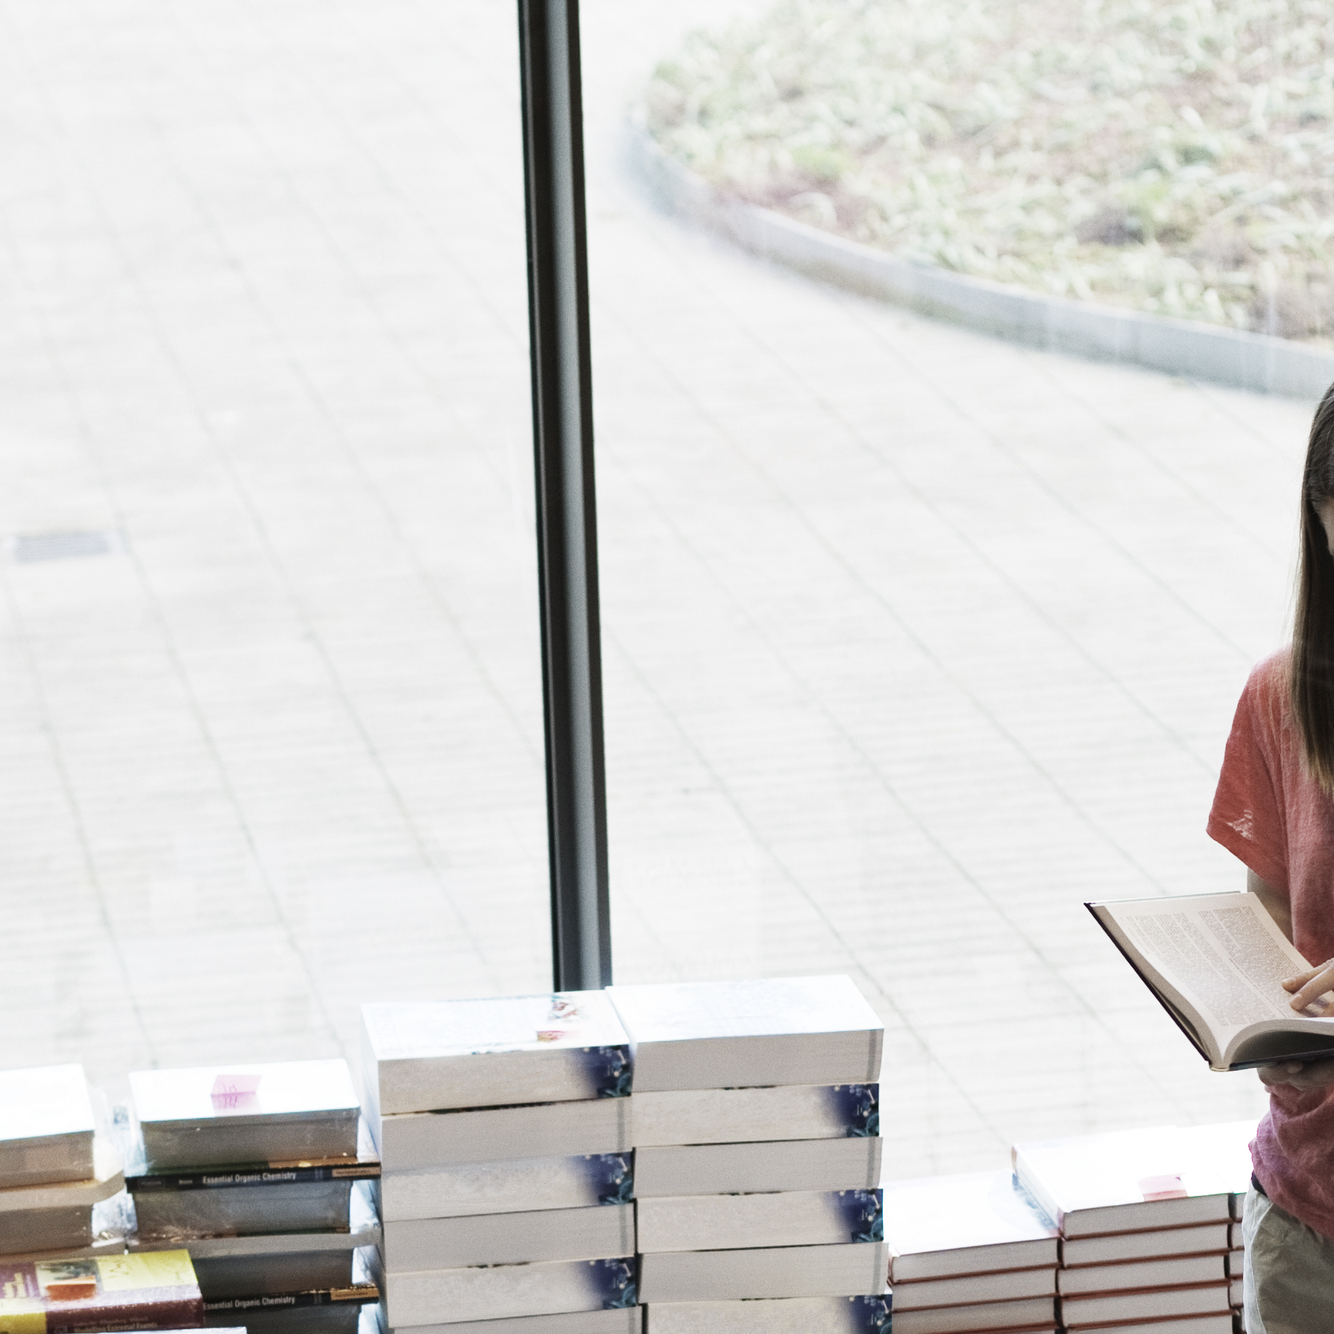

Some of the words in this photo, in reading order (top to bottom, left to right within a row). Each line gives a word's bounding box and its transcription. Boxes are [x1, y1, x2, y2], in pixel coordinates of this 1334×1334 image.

[202, 1173, 234, 1185] Essential
[235, 1173, 261, 1184] Organic
[262, 1171, 297, 1182] Chemistry
[235, 1298, 261, 1308] Organic
[262, 1296, 296, 1307] Chemistry
